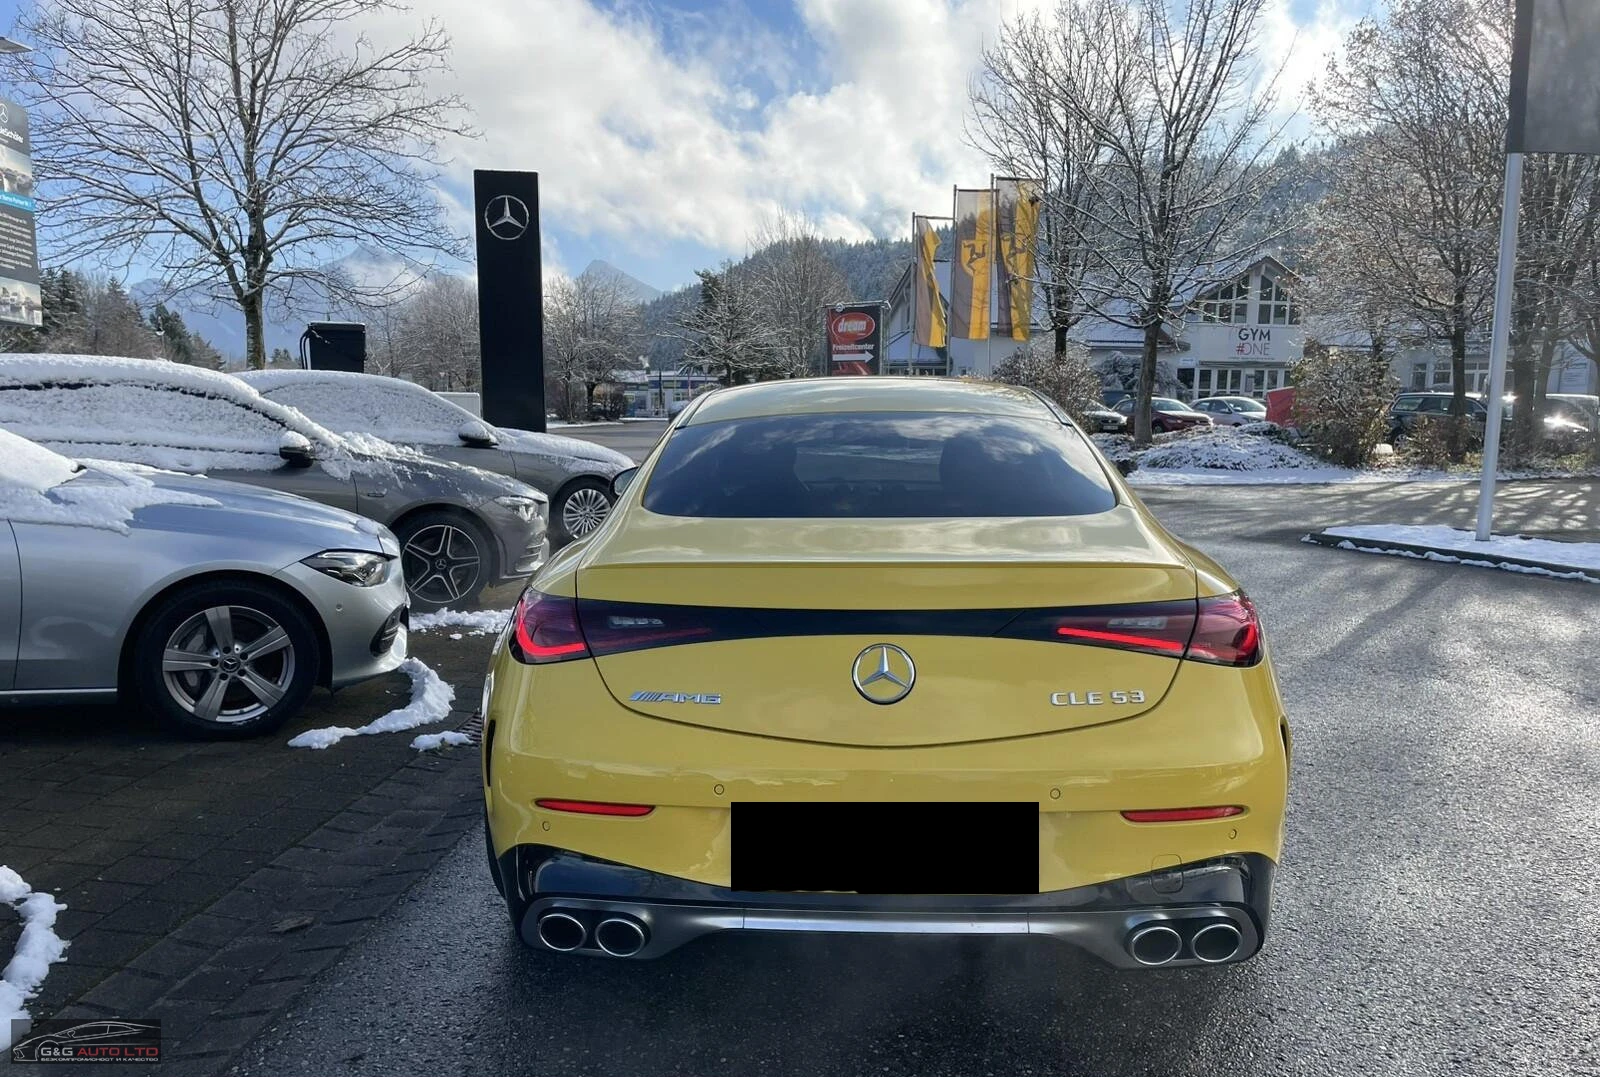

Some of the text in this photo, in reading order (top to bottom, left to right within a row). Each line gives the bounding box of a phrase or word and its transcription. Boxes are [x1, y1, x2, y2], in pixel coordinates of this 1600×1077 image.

[1239, 328, 1271, 341] GYM
[656, 692, 721, 705] AMG
[1050, 690, 1145, 706] CLE 53
